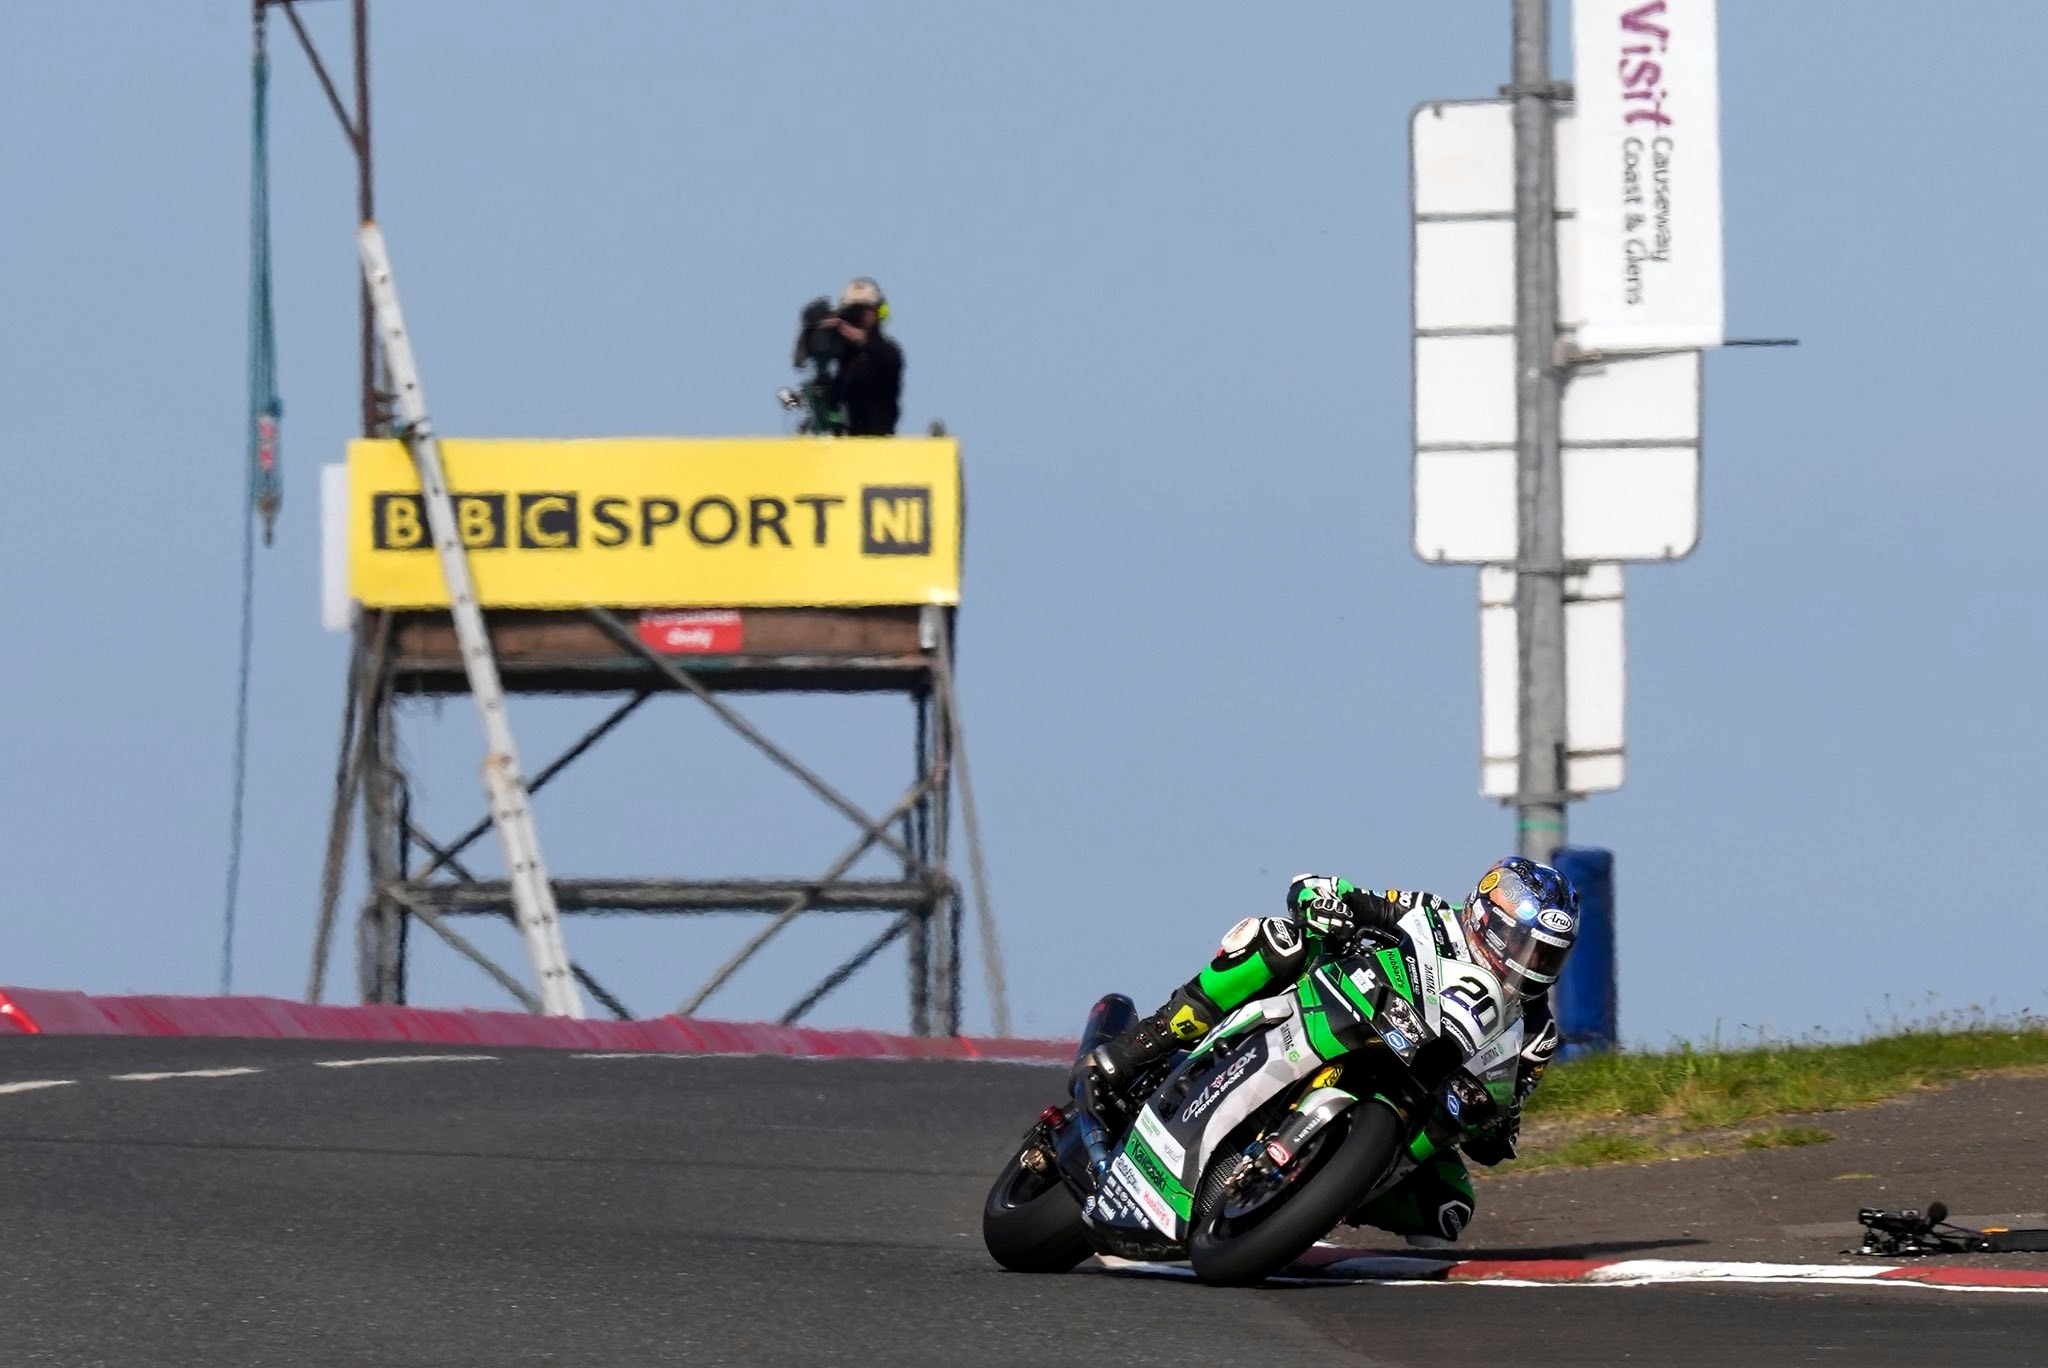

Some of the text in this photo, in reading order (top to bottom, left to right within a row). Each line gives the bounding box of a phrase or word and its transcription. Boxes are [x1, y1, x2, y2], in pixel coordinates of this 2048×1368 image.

[1620, 0, 1672, 126] Visit
[1622, 136, 1650, 305] Coast & Glens
[1651, 136, 1674, 262] Causeway
[374, 488, 927, 551] BBC SPORT NI
[1542, 912, 1571, 927] Arai
[1386, 950, 1405, 989] Hubbard's
[1439, 976, 1499, 1037] 20
[1194, 1067, 1245, 1118] MOTOR SPORT
[1131, 1138, 1169, 1192] Kawasaki
